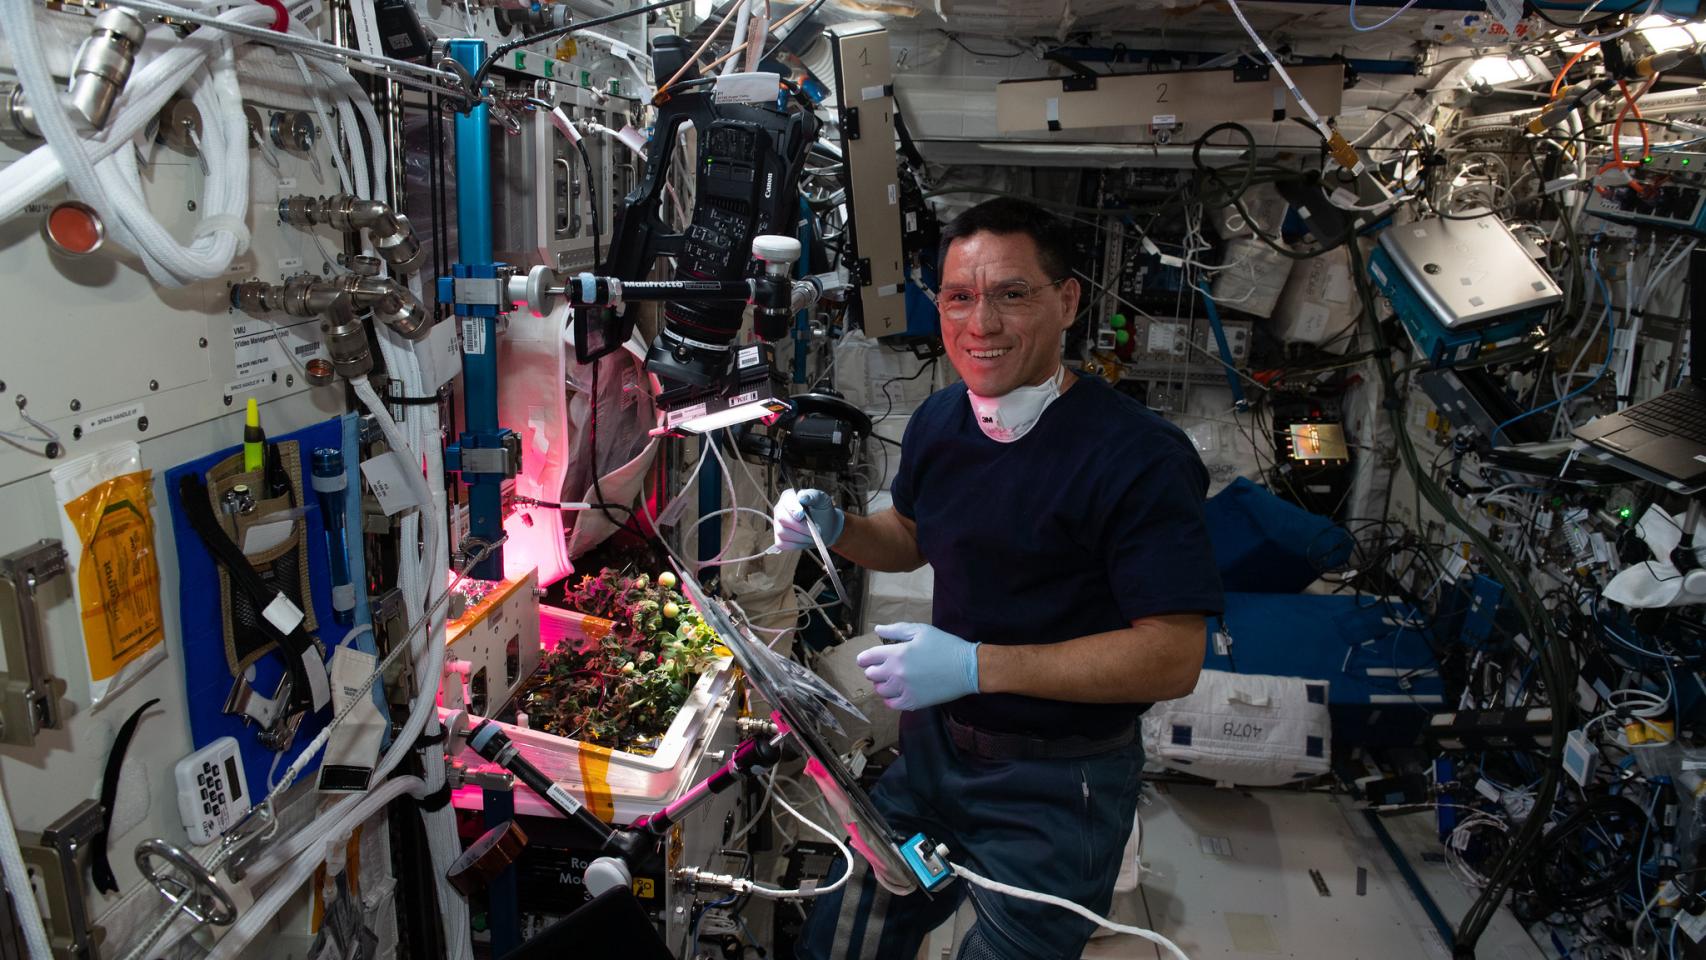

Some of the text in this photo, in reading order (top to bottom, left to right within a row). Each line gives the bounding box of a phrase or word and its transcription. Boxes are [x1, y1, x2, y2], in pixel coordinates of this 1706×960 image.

[858, 47, 872, 67] 1
[1156, 83, 1169, 103] 2
[764, 172, 773, 199] Canon
[623, 280, 684, 289] Manfrotto
[233, 326, 246, 336] VMU
[97, 415, 113, 425] SPACE
[113, 410, 132, 420] HANDLE
[981, 416, 994, 424] 3M
[1223, 722, 1263, 738] 4078
[571, 857, 592, 869] Ro
